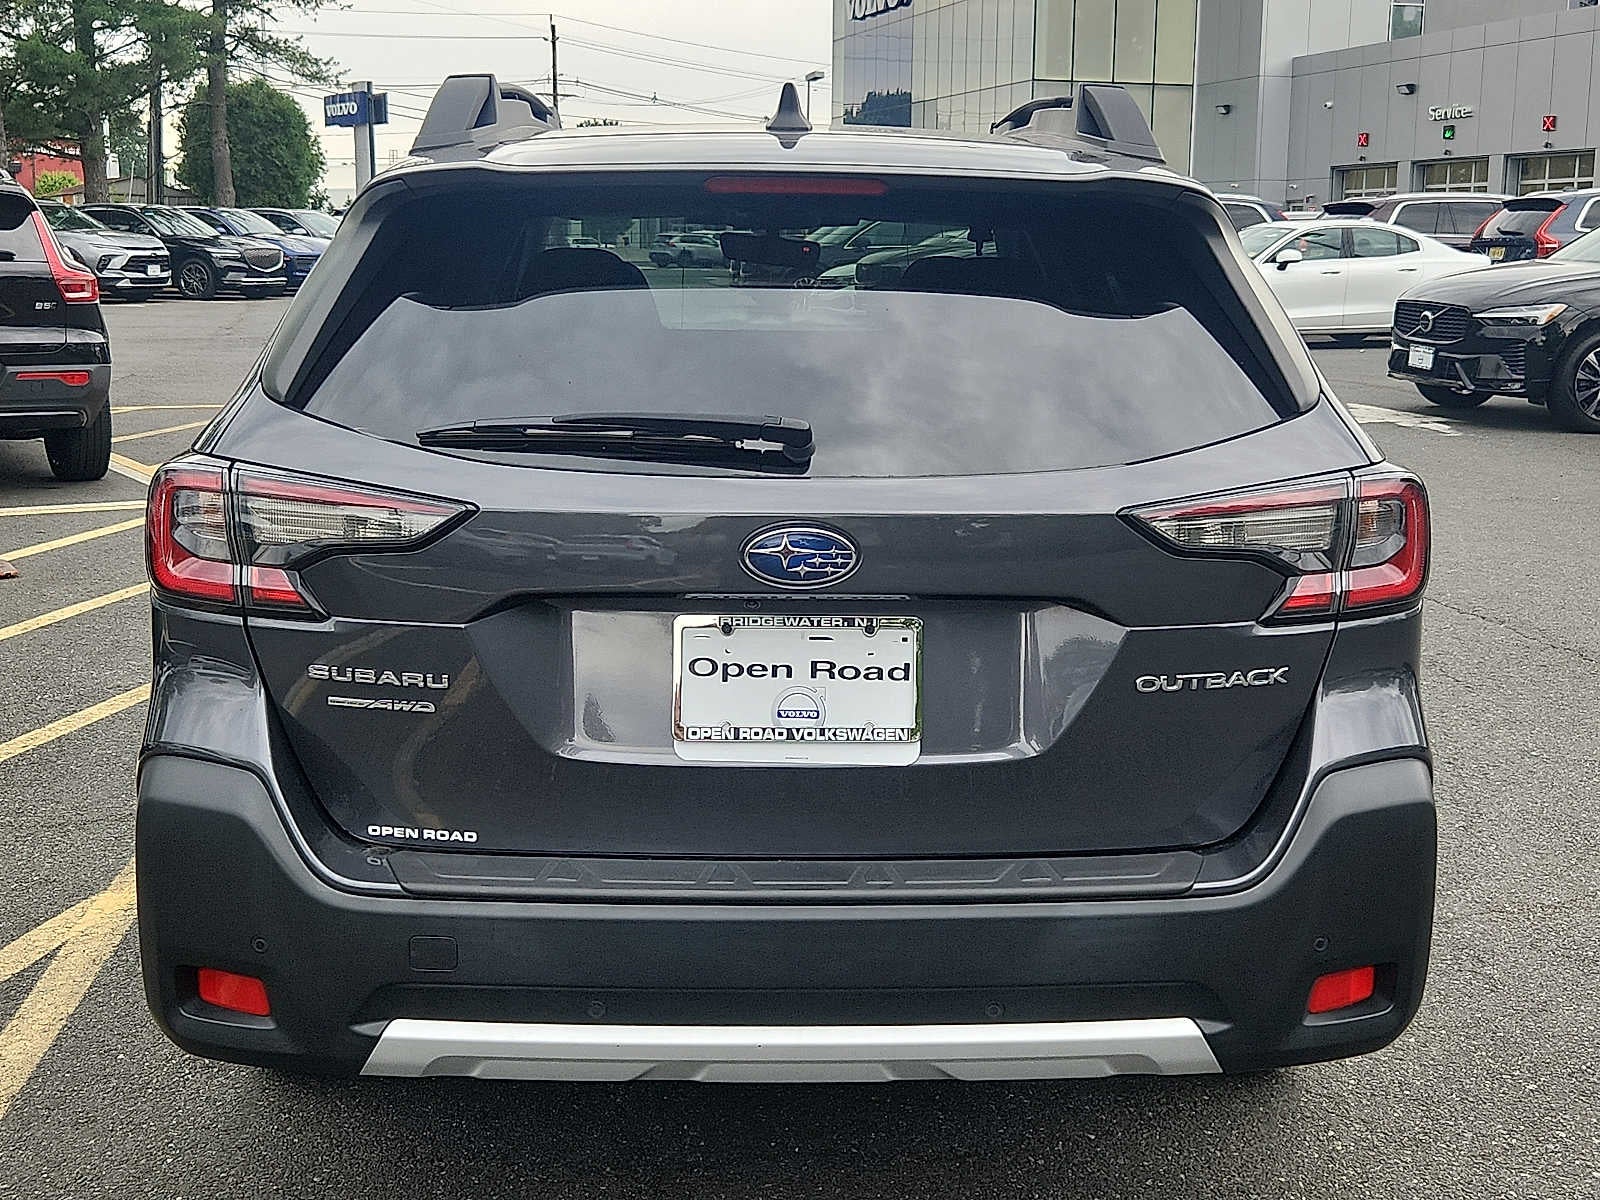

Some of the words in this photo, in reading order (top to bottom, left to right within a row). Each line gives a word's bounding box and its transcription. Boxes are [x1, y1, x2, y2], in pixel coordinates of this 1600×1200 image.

[325, 102, 358, 117] VOLVO
[1428, 104, 1473, 121] Service
[307, 664, 449, 689] SUBARU
[688, 657, 794, 683] Open
[810, 660, 911, 681] Road
[1136, 666, 1289, 692] OUTBACK
[367, 699, 437, 713] AWD
[778, 710, 818, 718] VOLVO
[688, 727, 735, 741] OPEN
[739, 727, 788, 741] ROAD
[793, 727, 910, 741] VOLKSWAGEN
[367, 825, 419, 839] OPEN
[423, 829, 478, 843] ROAD
